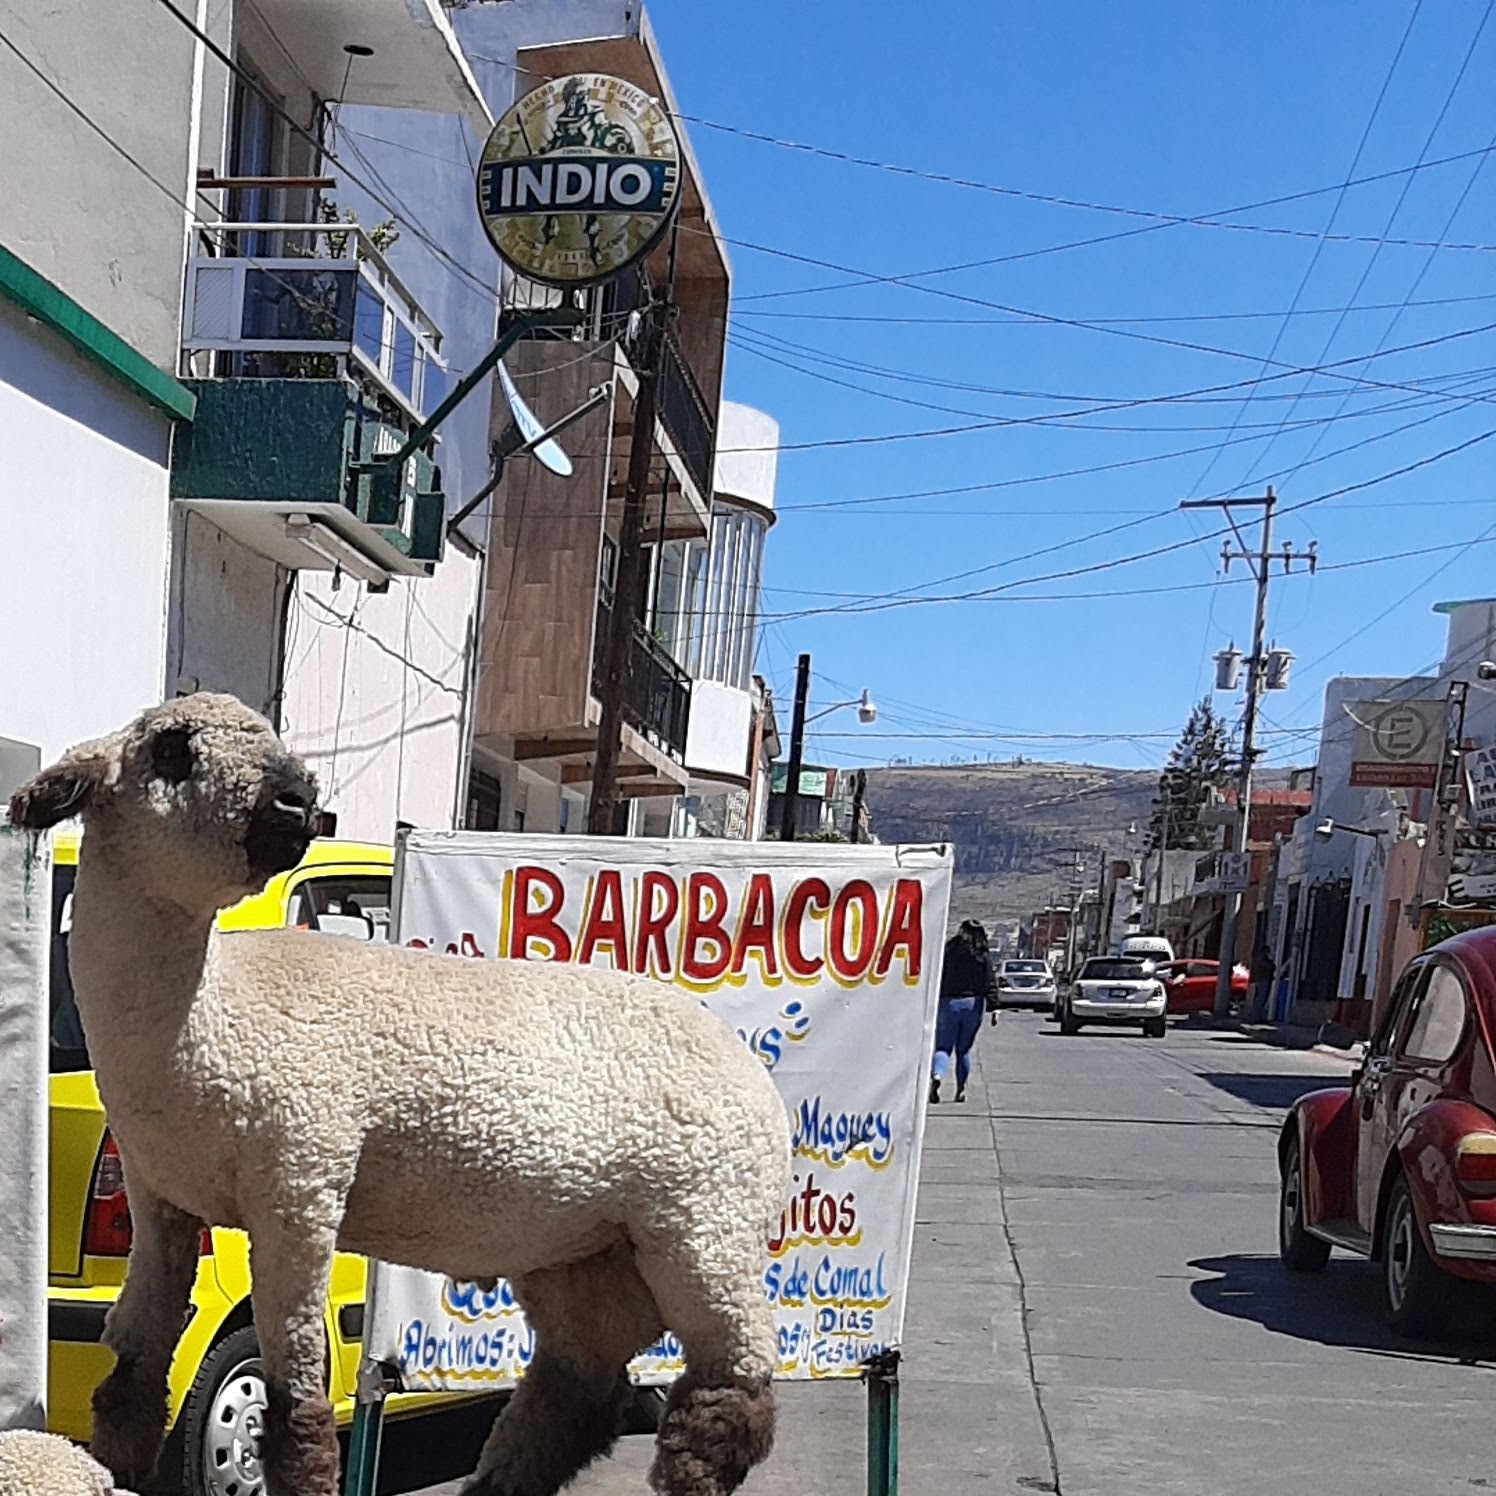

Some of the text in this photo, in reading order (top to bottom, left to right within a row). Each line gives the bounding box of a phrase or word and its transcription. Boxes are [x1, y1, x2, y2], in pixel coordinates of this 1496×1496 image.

[499, 162, 653, 208] INDIO
[507, 865, 924, 981] BARBACOA
[813, 1251, 888, 1299] Comal
[399, 1319, 515, 1369] Abrimos:
